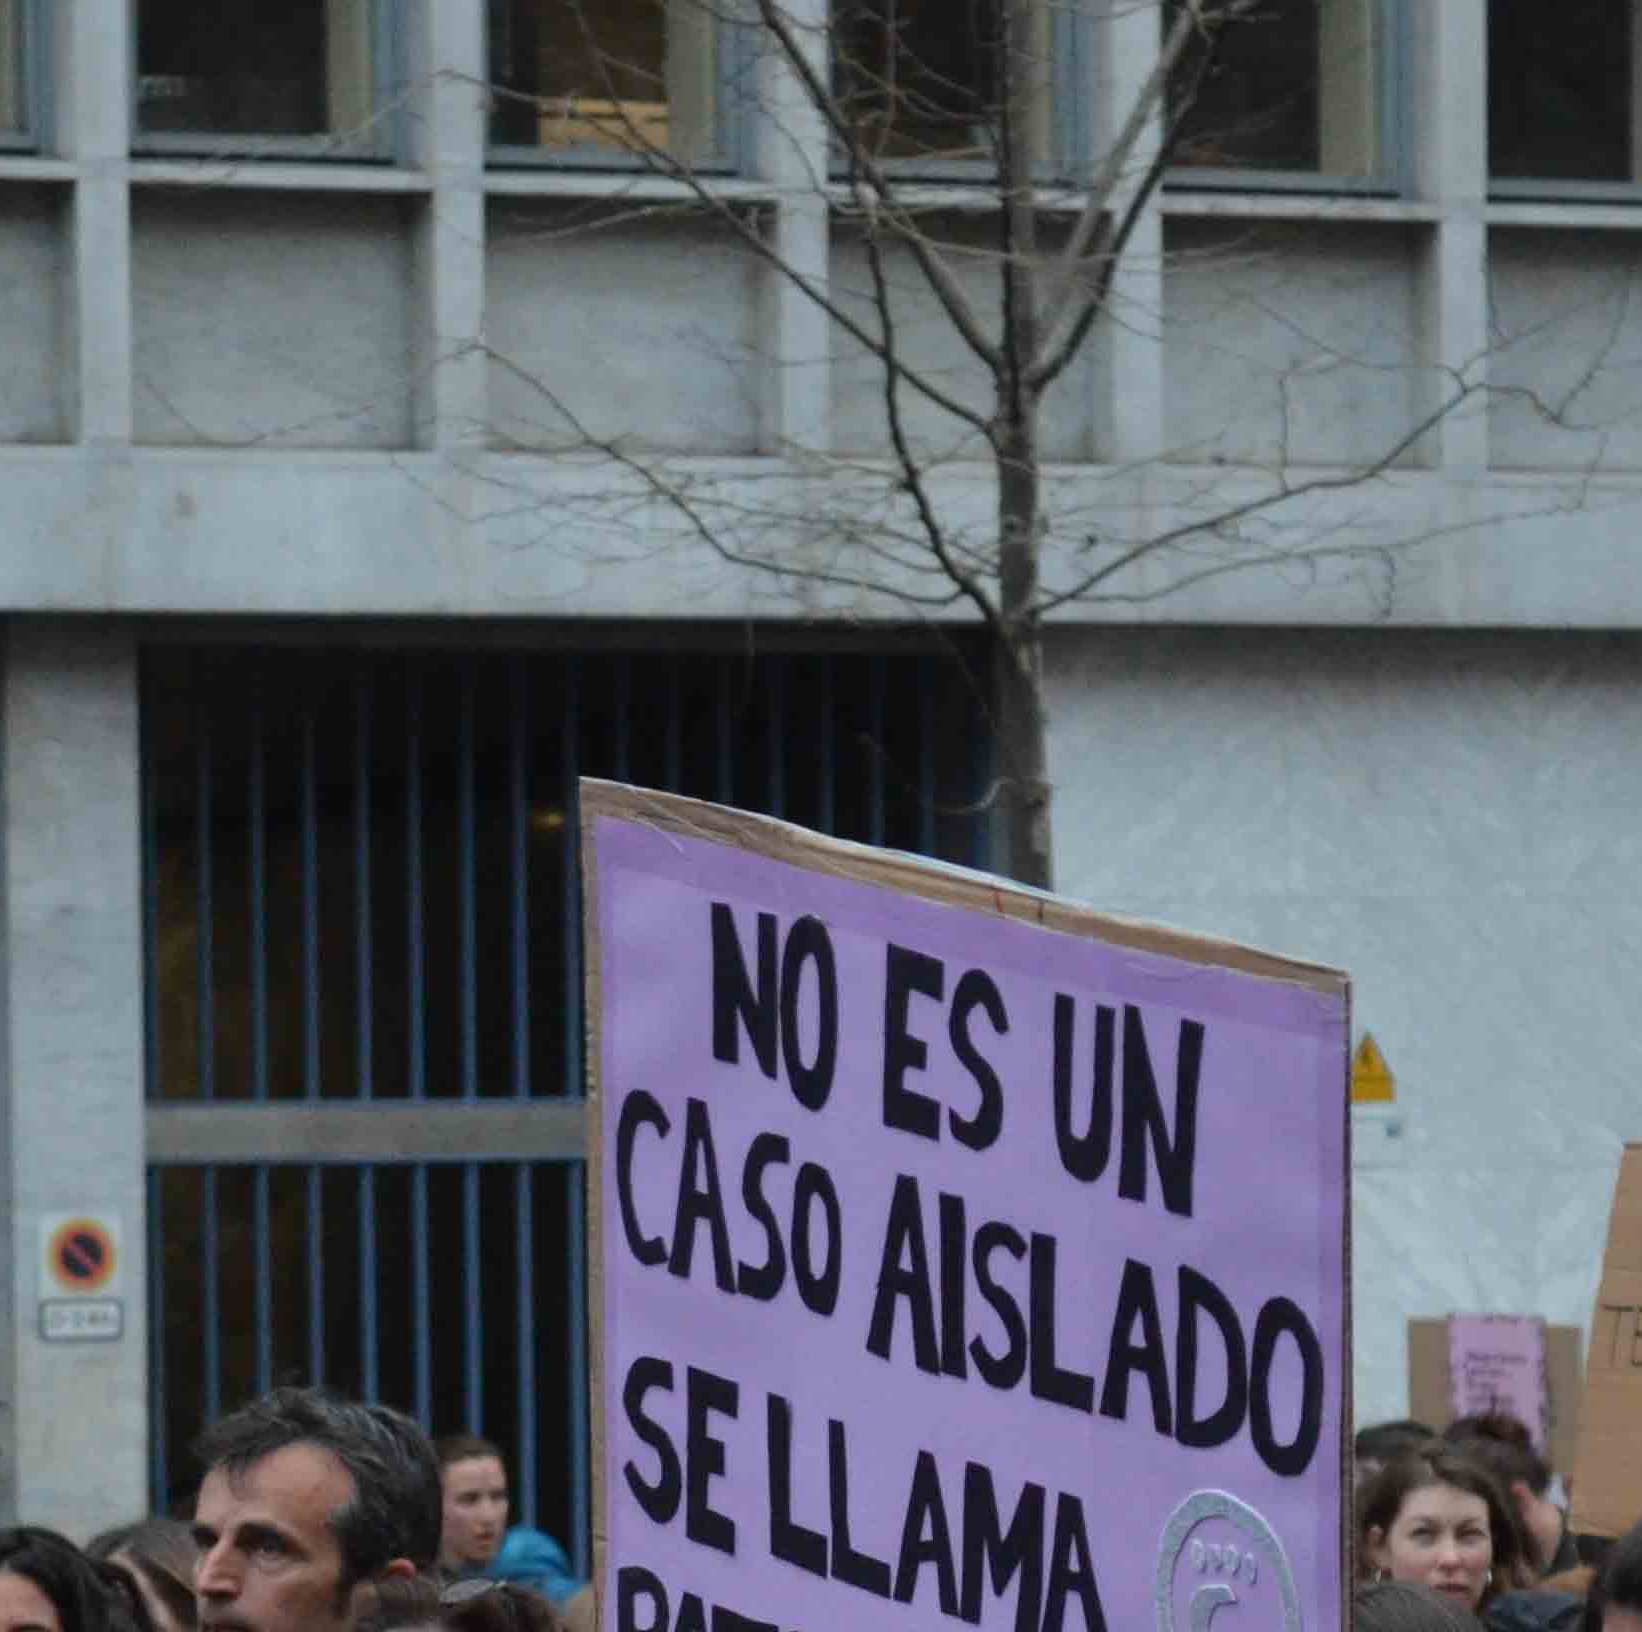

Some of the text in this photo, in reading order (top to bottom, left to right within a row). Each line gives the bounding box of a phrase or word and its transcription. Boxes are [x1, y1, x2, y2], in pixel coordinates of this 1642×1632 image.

[709, 901, 1205, 1218] NO ES UN
[615, 1087, 1324, 1478] CASO AISLADO
[621, 1354, 741, 1556] SE
